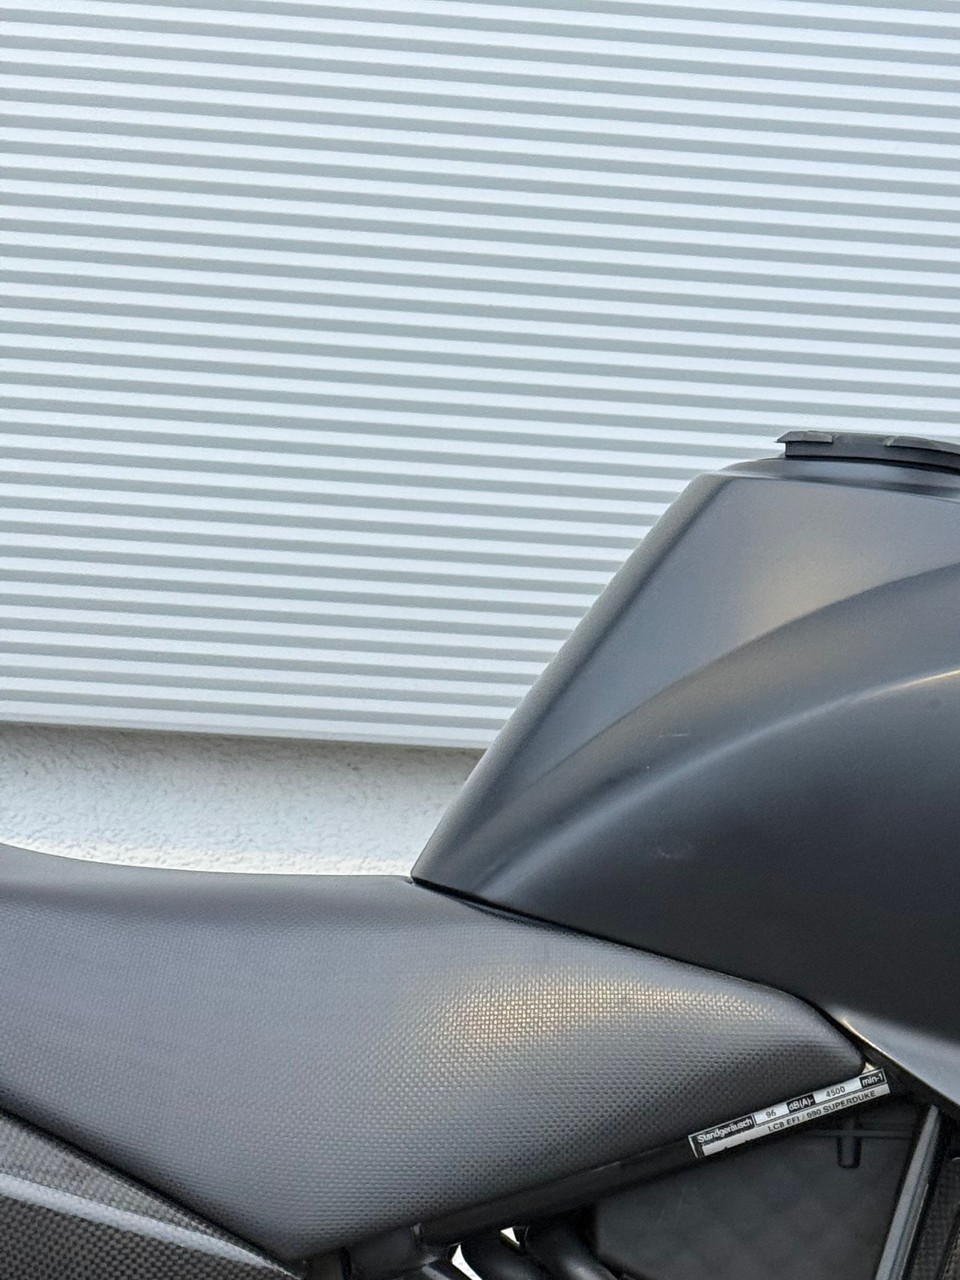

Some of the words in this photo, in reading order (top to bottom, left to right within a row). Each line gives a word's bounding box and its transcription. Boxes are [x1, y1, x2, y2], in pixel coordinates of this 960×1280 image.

[697, 1117, 753, 1144] Standgeräusch
[765, 1109, 777, 1119] 96
[825, 1086, 846, 1098] 4500
[787, 1116, 800, 1127] EFI
[823, 1090, 876, 1113] SUPERDUKE
